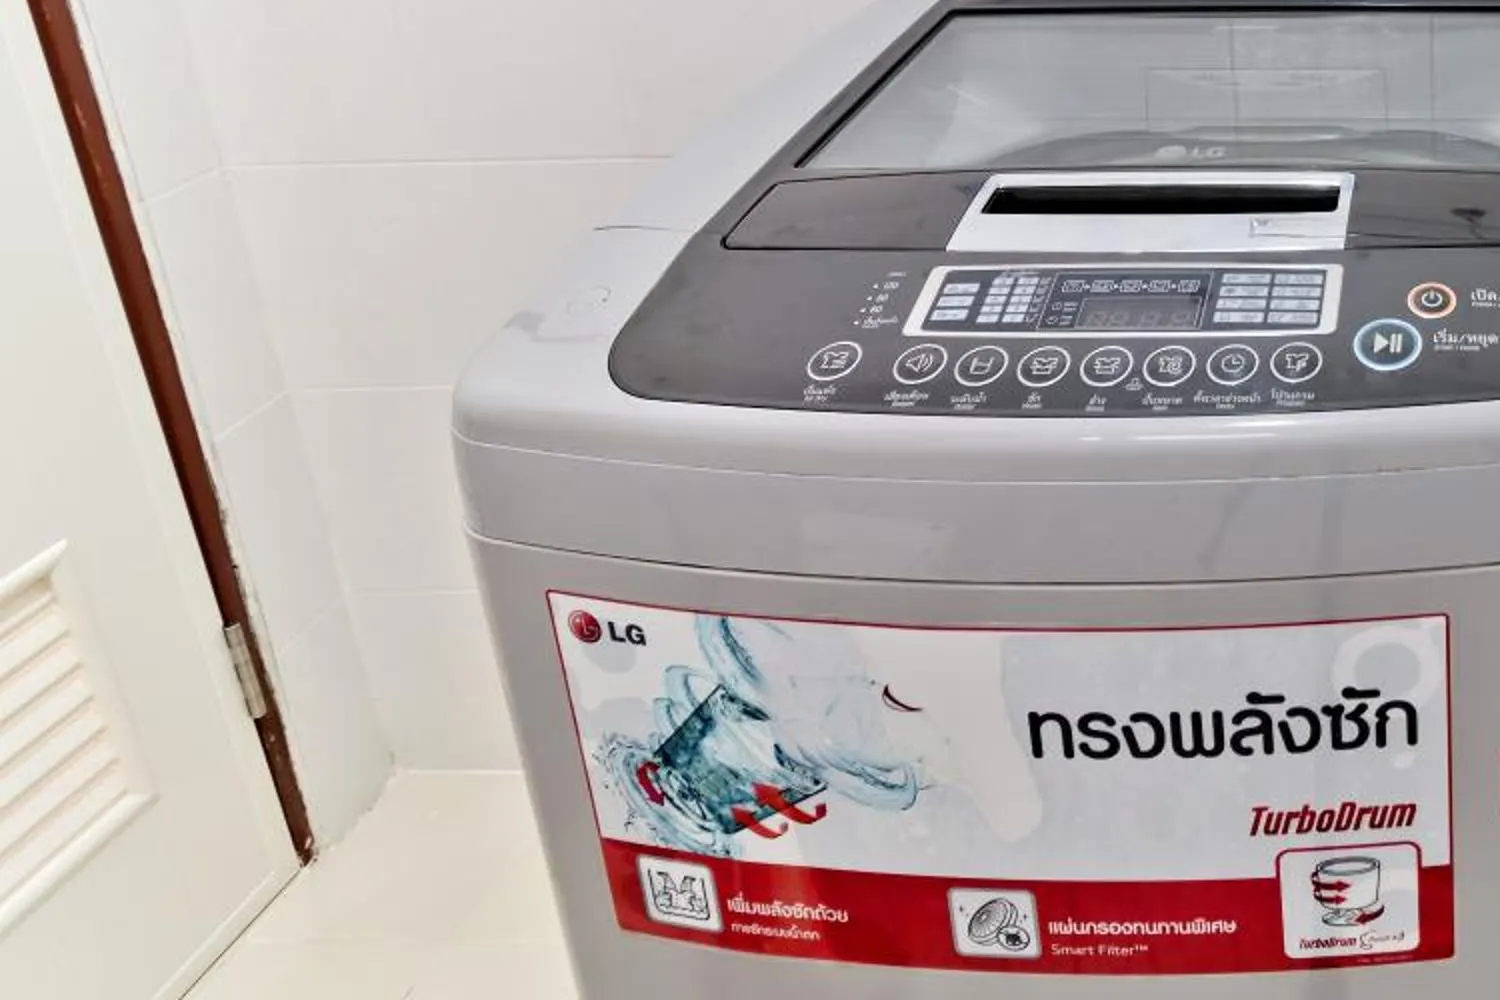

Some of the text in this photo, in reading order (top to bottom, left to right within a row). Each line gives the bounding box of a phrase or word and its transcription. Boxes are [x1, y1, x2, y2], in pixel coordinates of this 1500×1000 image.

[607, 620, 647, 646] LG
[1027, 687, 1419, 760] ทรงพลังซัก
[1249, 802, 1417, 837] TurboDrum
[1051, 943, 1095, 957] Smart
